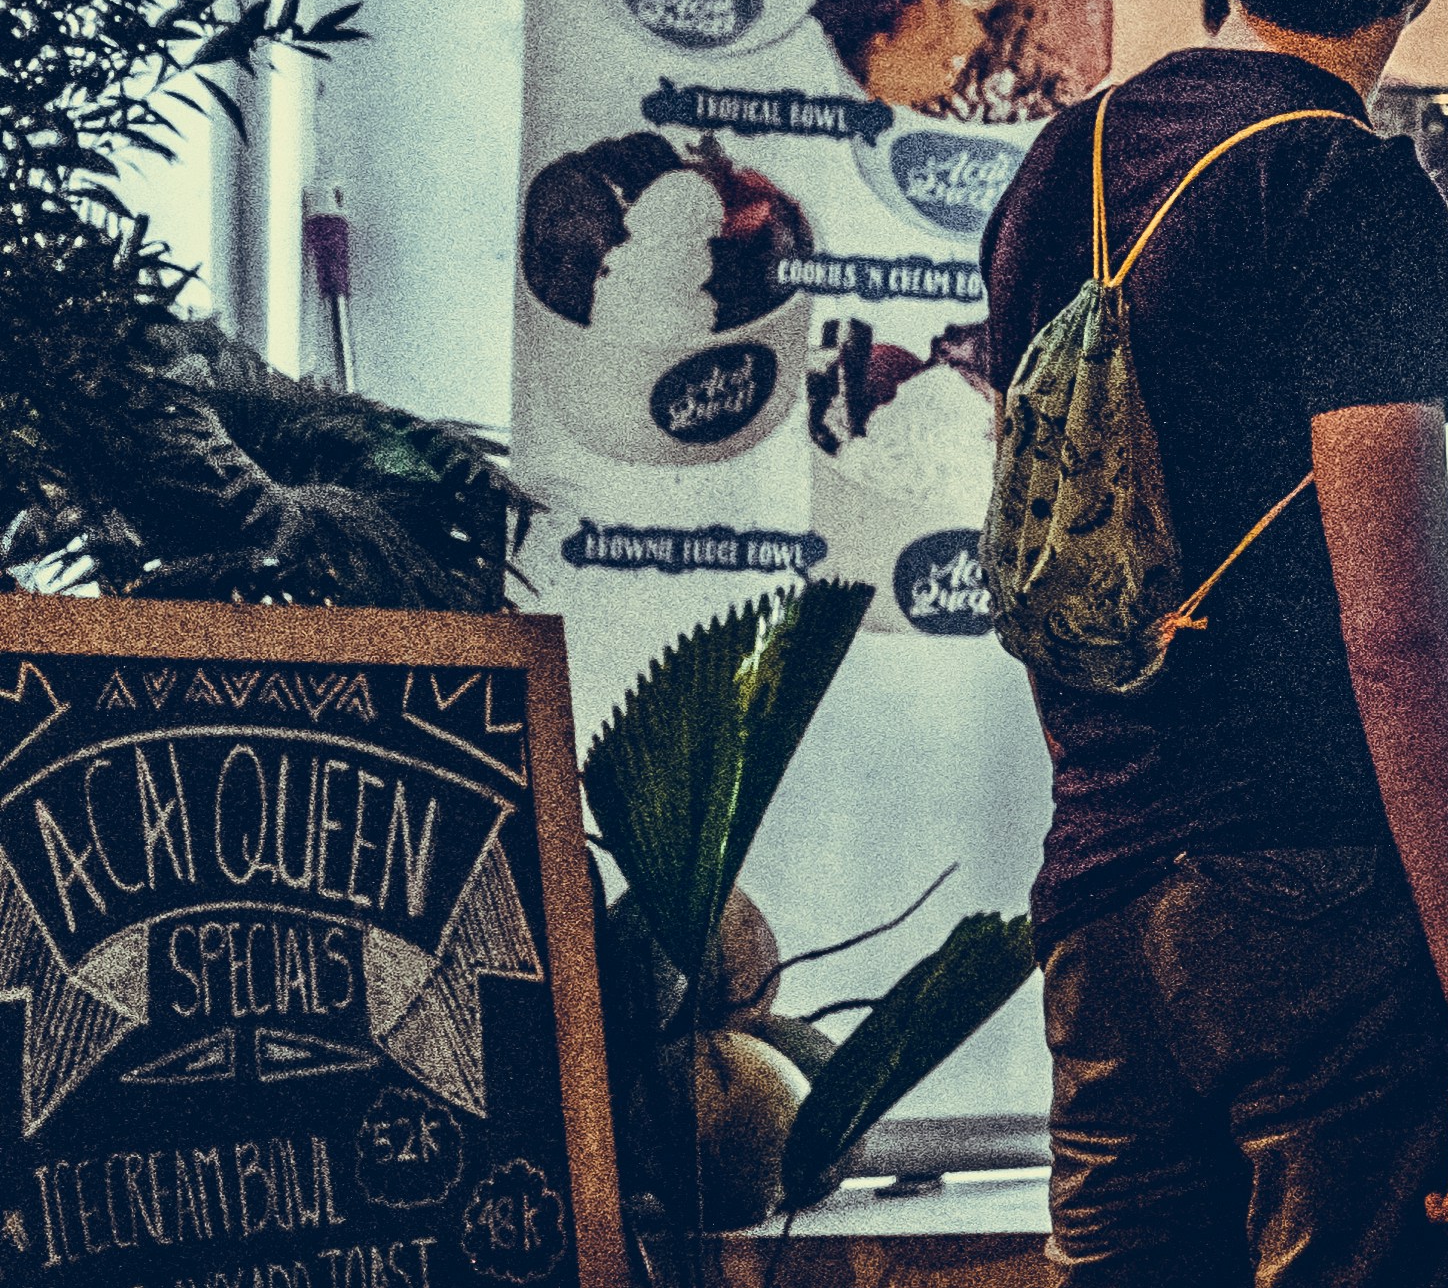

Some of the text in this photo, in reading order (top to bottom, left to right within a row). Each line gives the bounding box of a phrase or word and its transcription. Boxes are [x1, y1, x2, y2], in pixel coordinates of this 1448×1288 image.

[695, 92, 849, 132] TROPICAL BOWL
[214, 744, 440, 917] QUEEN
[168, 920, 356, 1018] SPECIALS
[236, 1135, 347, 1237] BOWL
